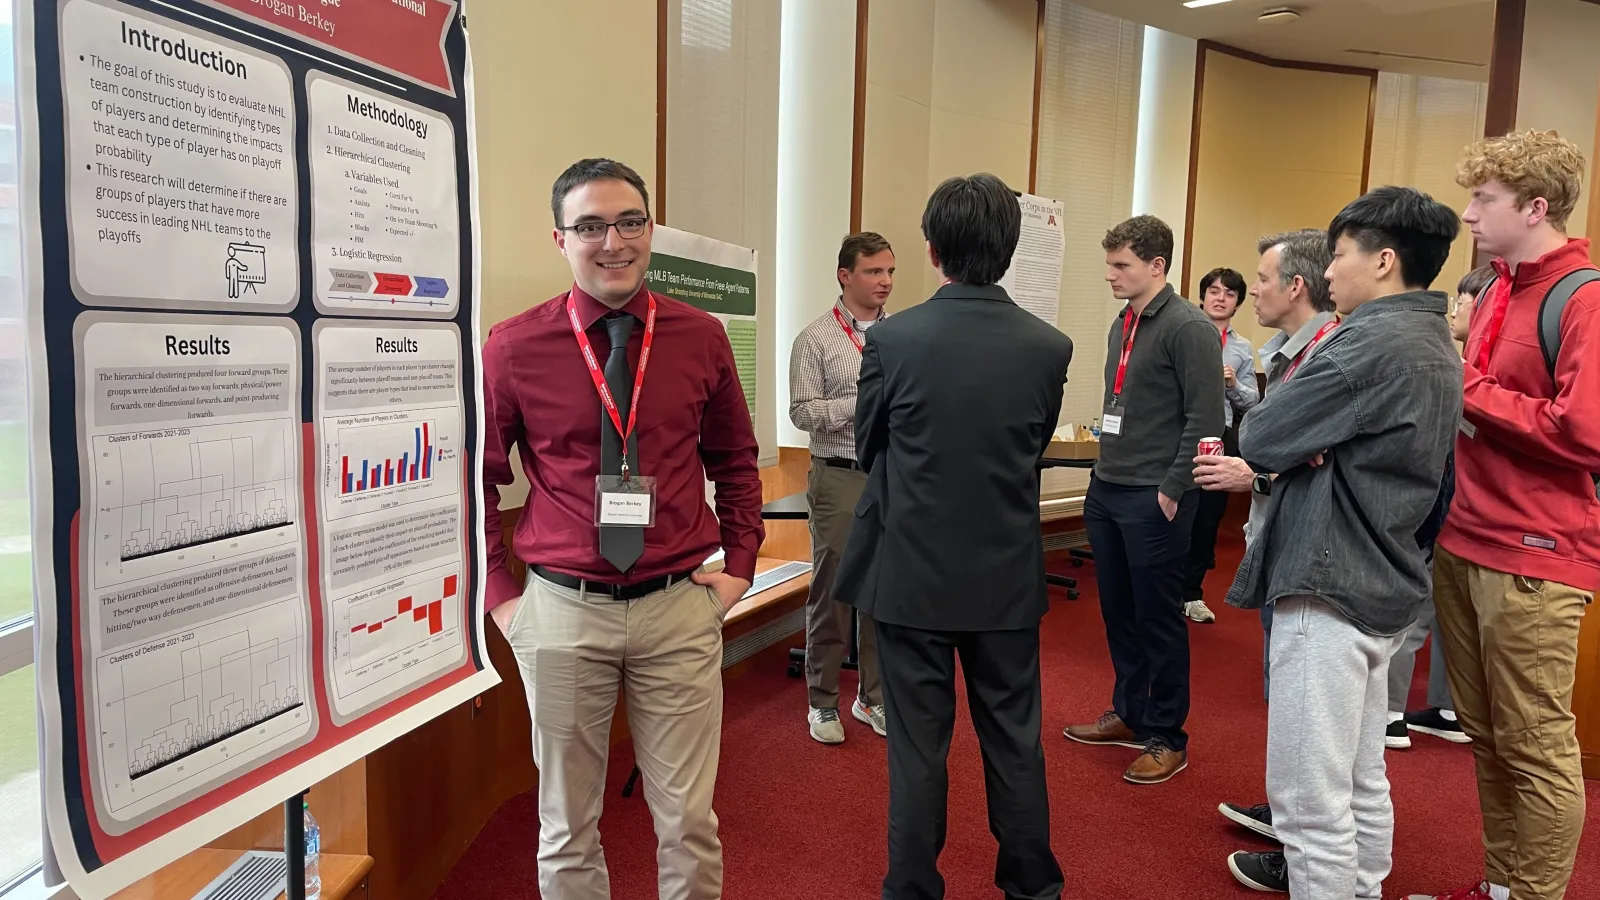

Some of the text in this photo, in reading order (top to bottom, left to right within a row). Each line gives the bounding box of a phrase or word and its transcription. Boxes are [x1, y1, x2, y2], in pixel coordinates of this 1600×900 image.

[298, 5, 335, 37] Berkey
[121, 21, 247, 79] Introduction
[91, 54, 286, 119] The goal of this study is to evaluate NHL
[90, 78, 281, 135] team construction by identifying types
[347, 94, 428, 139] Methodology
[92, 99, 283, 153] of players and determining the impacts
[93, 120, 282, 171] that each type of player has on playoff
[95, 144, 152, 166] probability
[327, 125, 426, 160] 1. Data Collection and Cleaning
[326, 145, 411, 175] 2. Hierarchical Clustering
[98, 163, 287, 207] This research will determine if there are
[351, 170, 383, 185] Variables
[383, 177, 399, 189] Used
[354, 186, 367, 194] Goals
[95, 186, 260, 220] groups of players that have more
[354, 199, 370, 207] Assists
[96, 208, 271, 240] success in leading NHL teams to the
[98, 228, 142, 245] playoffs
[331, 247, 402, 263] 3. Logistic Regression
[654, 270, 666, 282] MLB
[667, 272, 679, 283] Team
[681, 274, 705, 287] Performance
[715, 280, 724, 290] Free
[726, 282, 736, 293] Agent
[165, 335, 230, 355] Results
[376, 337, 418, 353] Results
[99, 373, 113, 381] The
[114, 371, 155, 381] hierarchical
[155, 371, 187, 380] clustering
[187, 370, 214, 380] produced
[228, 368, 252, 376] forward
[107, 389, 132, 397] groups
[149, 384, 180, 394] identified
[143, 398, 195, 409] one-dimensional
[139, 432, 164, 440] Forwards
[164, 428, 191, 438] 2021-2023
[101, 597, 117, 606] The
[117, 584, 160, 602] hierarchical
[160, 578, 193, 591] clustering
[193, 568, 222, 585] produced
[223, 567, 238, 575] three
[239, 562, 258, 572] groups
[258, 558, 265, 566] of
[112, 607, 134, 618] These
[135, 600, 159, 614] groups
[159, 596, 176, 605] were
[176, 586, 207, 601] identified
[214, 578, 241, 590] offensive
[106, 614, 162, 634] hitting/two-way
[203, 596, 215, 607] and
[109, 632, 195, 665] Clusters of Defense 2021-2023
